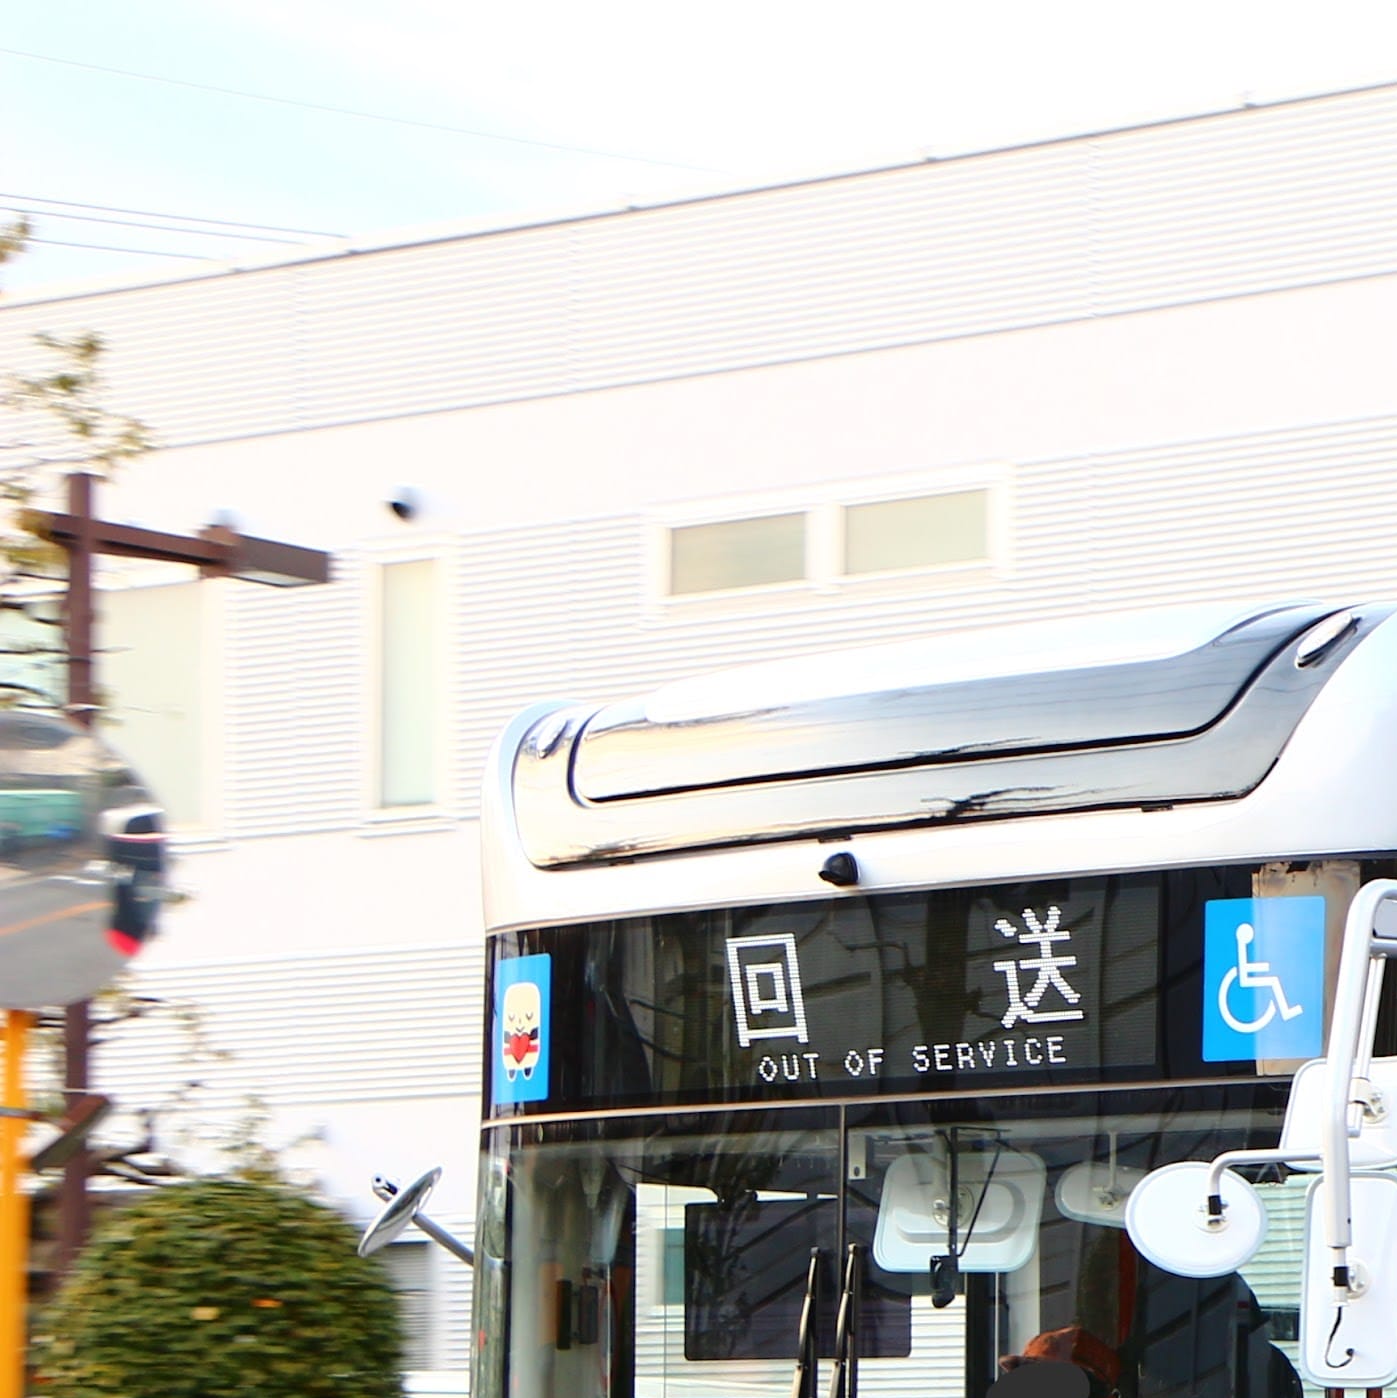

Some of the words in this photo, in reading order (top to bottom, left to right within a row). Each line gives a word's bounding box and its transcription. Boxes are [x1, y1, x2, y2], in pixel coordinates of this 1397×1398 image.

[758, 1052, 819, 1082] OUT
[844, 1048, 884, 1076] OF
[912, 1036, 1067, 1072] SERVICE
